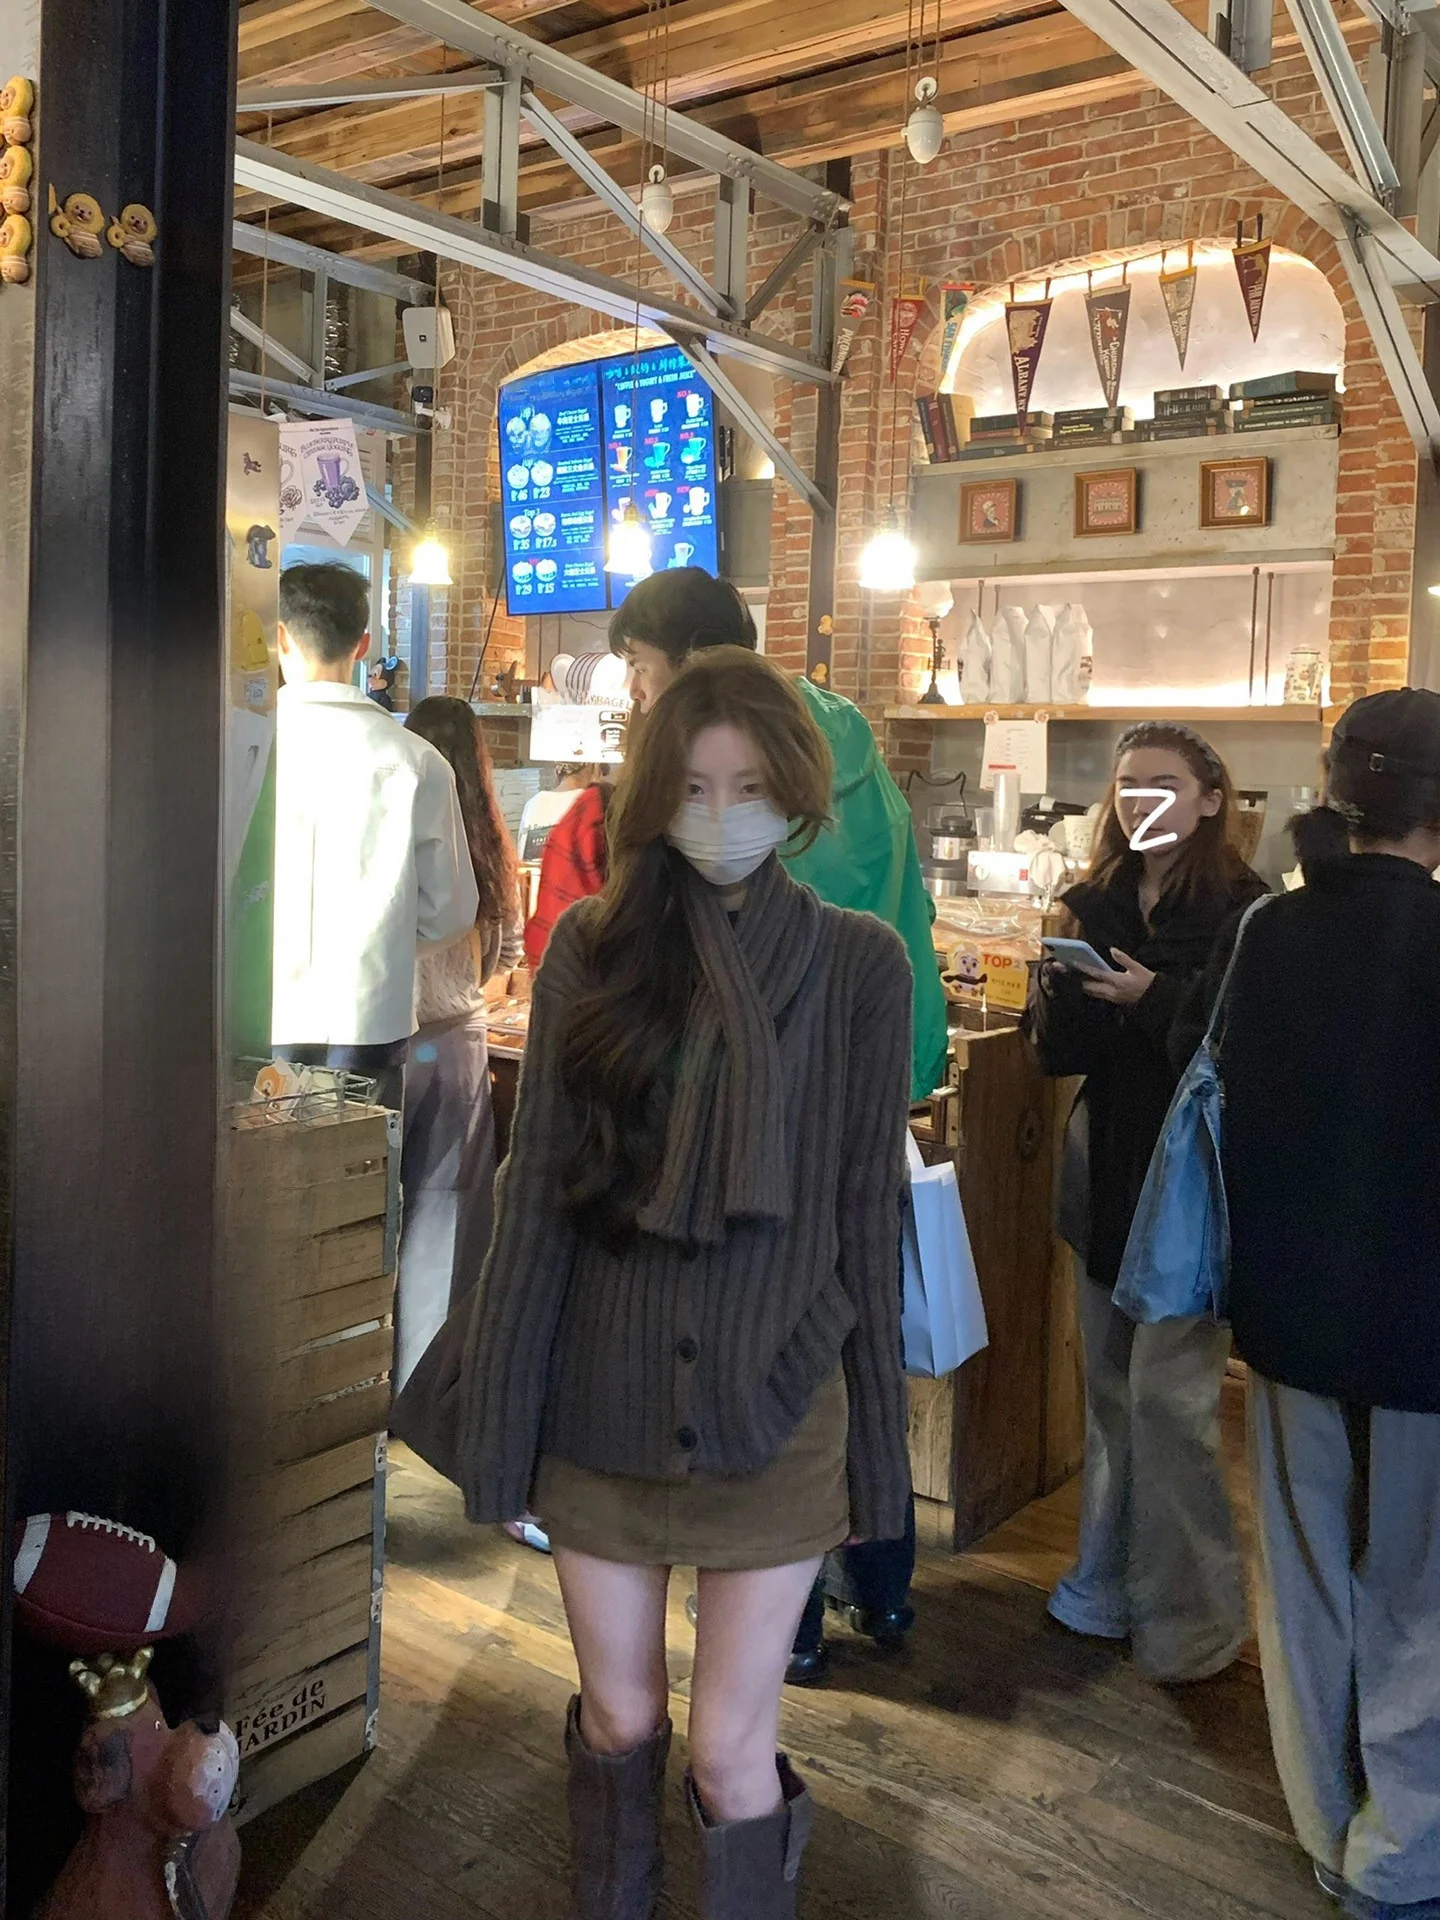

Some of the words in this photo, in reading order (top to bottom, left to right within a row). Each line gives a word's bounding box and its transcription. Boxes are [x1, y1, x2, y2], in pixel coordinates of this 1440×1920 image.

[983, 954, 1012, 969] TOP
[235, 1703, 284, 1739] Fée
[292, 1679, 324, 1706] de
